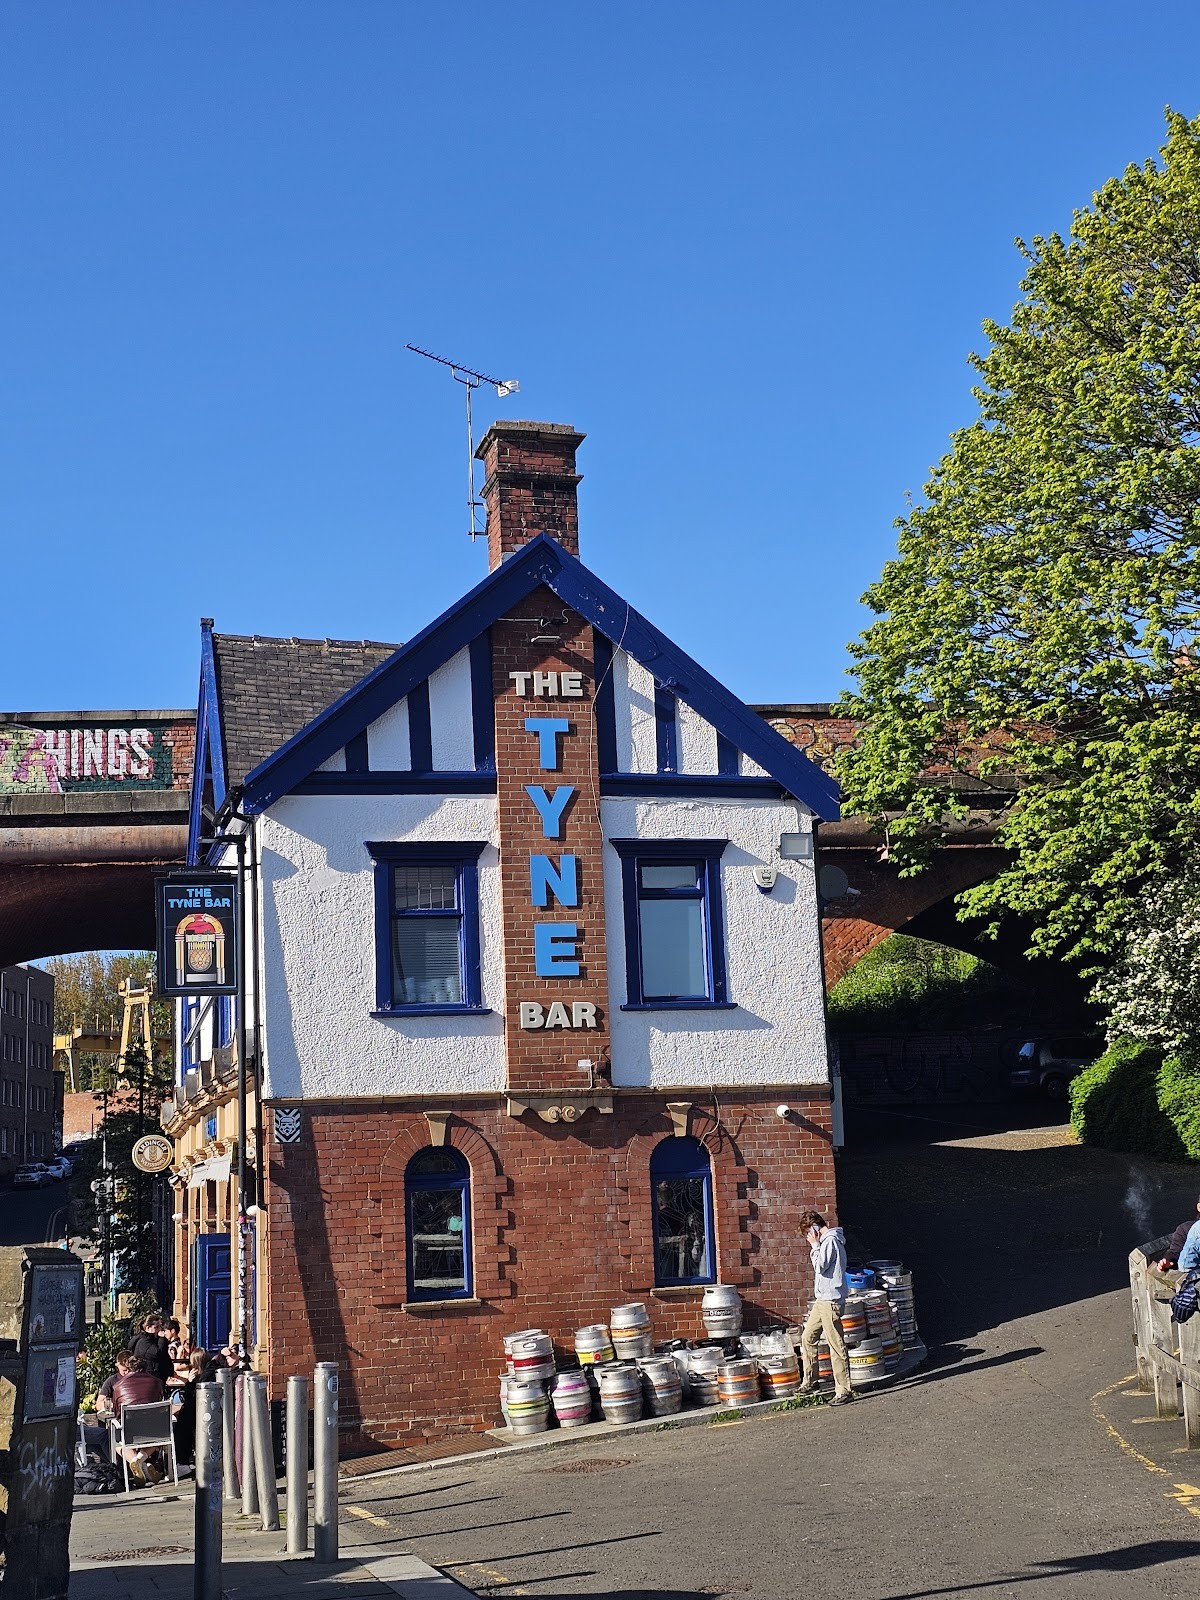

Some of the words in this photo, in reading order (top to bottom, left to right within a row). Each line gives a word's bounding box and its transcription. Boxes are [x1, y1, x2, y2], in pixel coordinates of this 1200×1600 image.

[509, 671, 584, 698] THE
[524, 718, 580, 977] TYNE
[168, 898, 201, 908] TYNE
[205, 898, 231, 908] BAR
[186, 888, 212, 898] THE
[520, 1001, 597, 1029] BAR
[138, 1140, 168, 1153] ERDINGER
